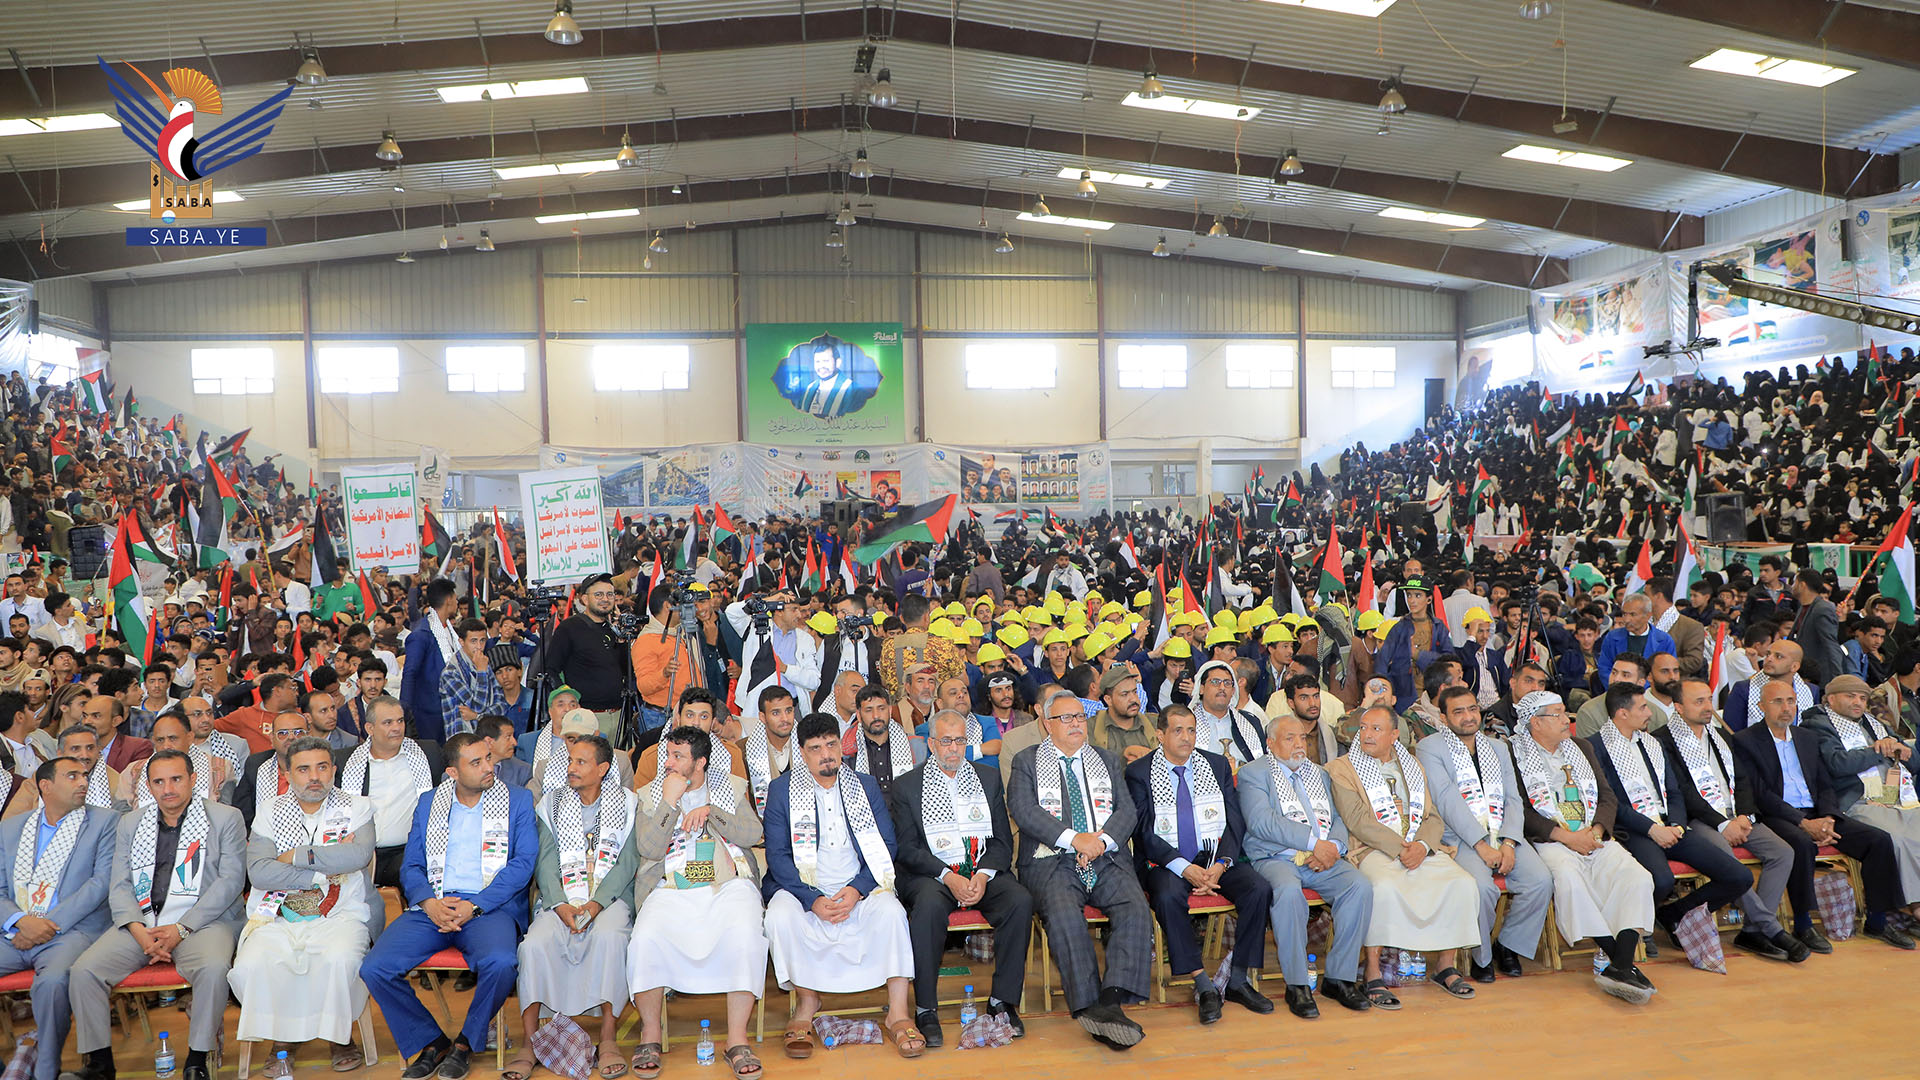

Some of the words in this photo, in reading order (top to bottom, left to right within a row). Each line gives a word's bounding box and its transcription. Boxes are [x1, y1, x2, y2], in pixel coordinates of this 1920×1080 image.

[348, 480, 412, 505] قاطعوا
[537, 483, 573, 509] أكبر
[574, 483, 598, 500] الله
[351, 505, 384, 526] الأمريكية
[385, 505, 413, 524] البضائع
[571, 504, 599, 519] الموت
[380, 526, 386, 540] و
[572, 521, 600, 536] الموت
[540, 540, 563, 557] اليهود
[564, 539, 578, 554] على
[580, 536, 602, 550] اللعنة
[575, 551, 604, 573] النصر
[262, 722, 273, 735] B
